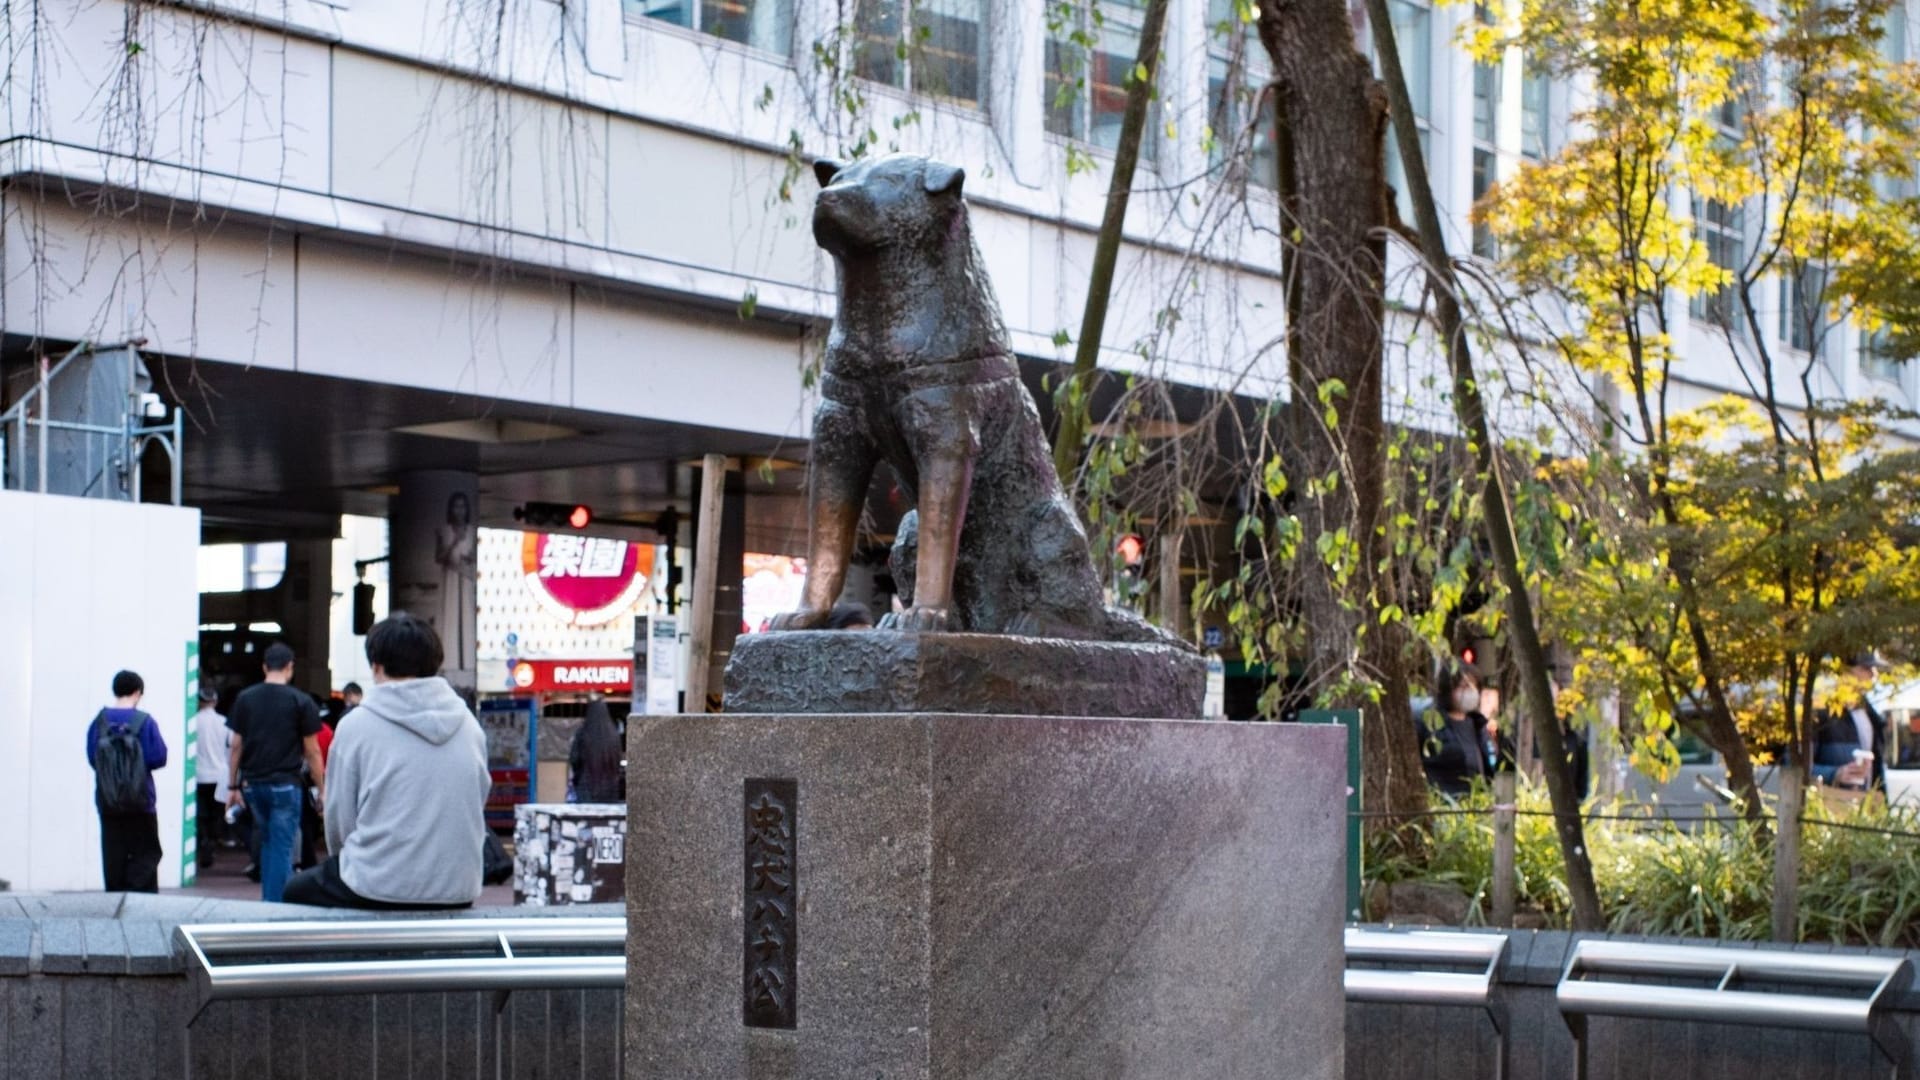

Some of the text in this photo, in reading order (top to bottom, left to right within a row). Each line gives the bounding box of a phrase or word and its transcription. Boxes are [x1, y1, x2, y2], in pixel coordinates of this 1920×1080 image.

[540, 534, 627, 577] 楽園
[554, 667, 629, 683] RAKUEN
[594, 837, 621, 860] NERO
[750, 793, 789, 1009] 忠犬ハチ公
